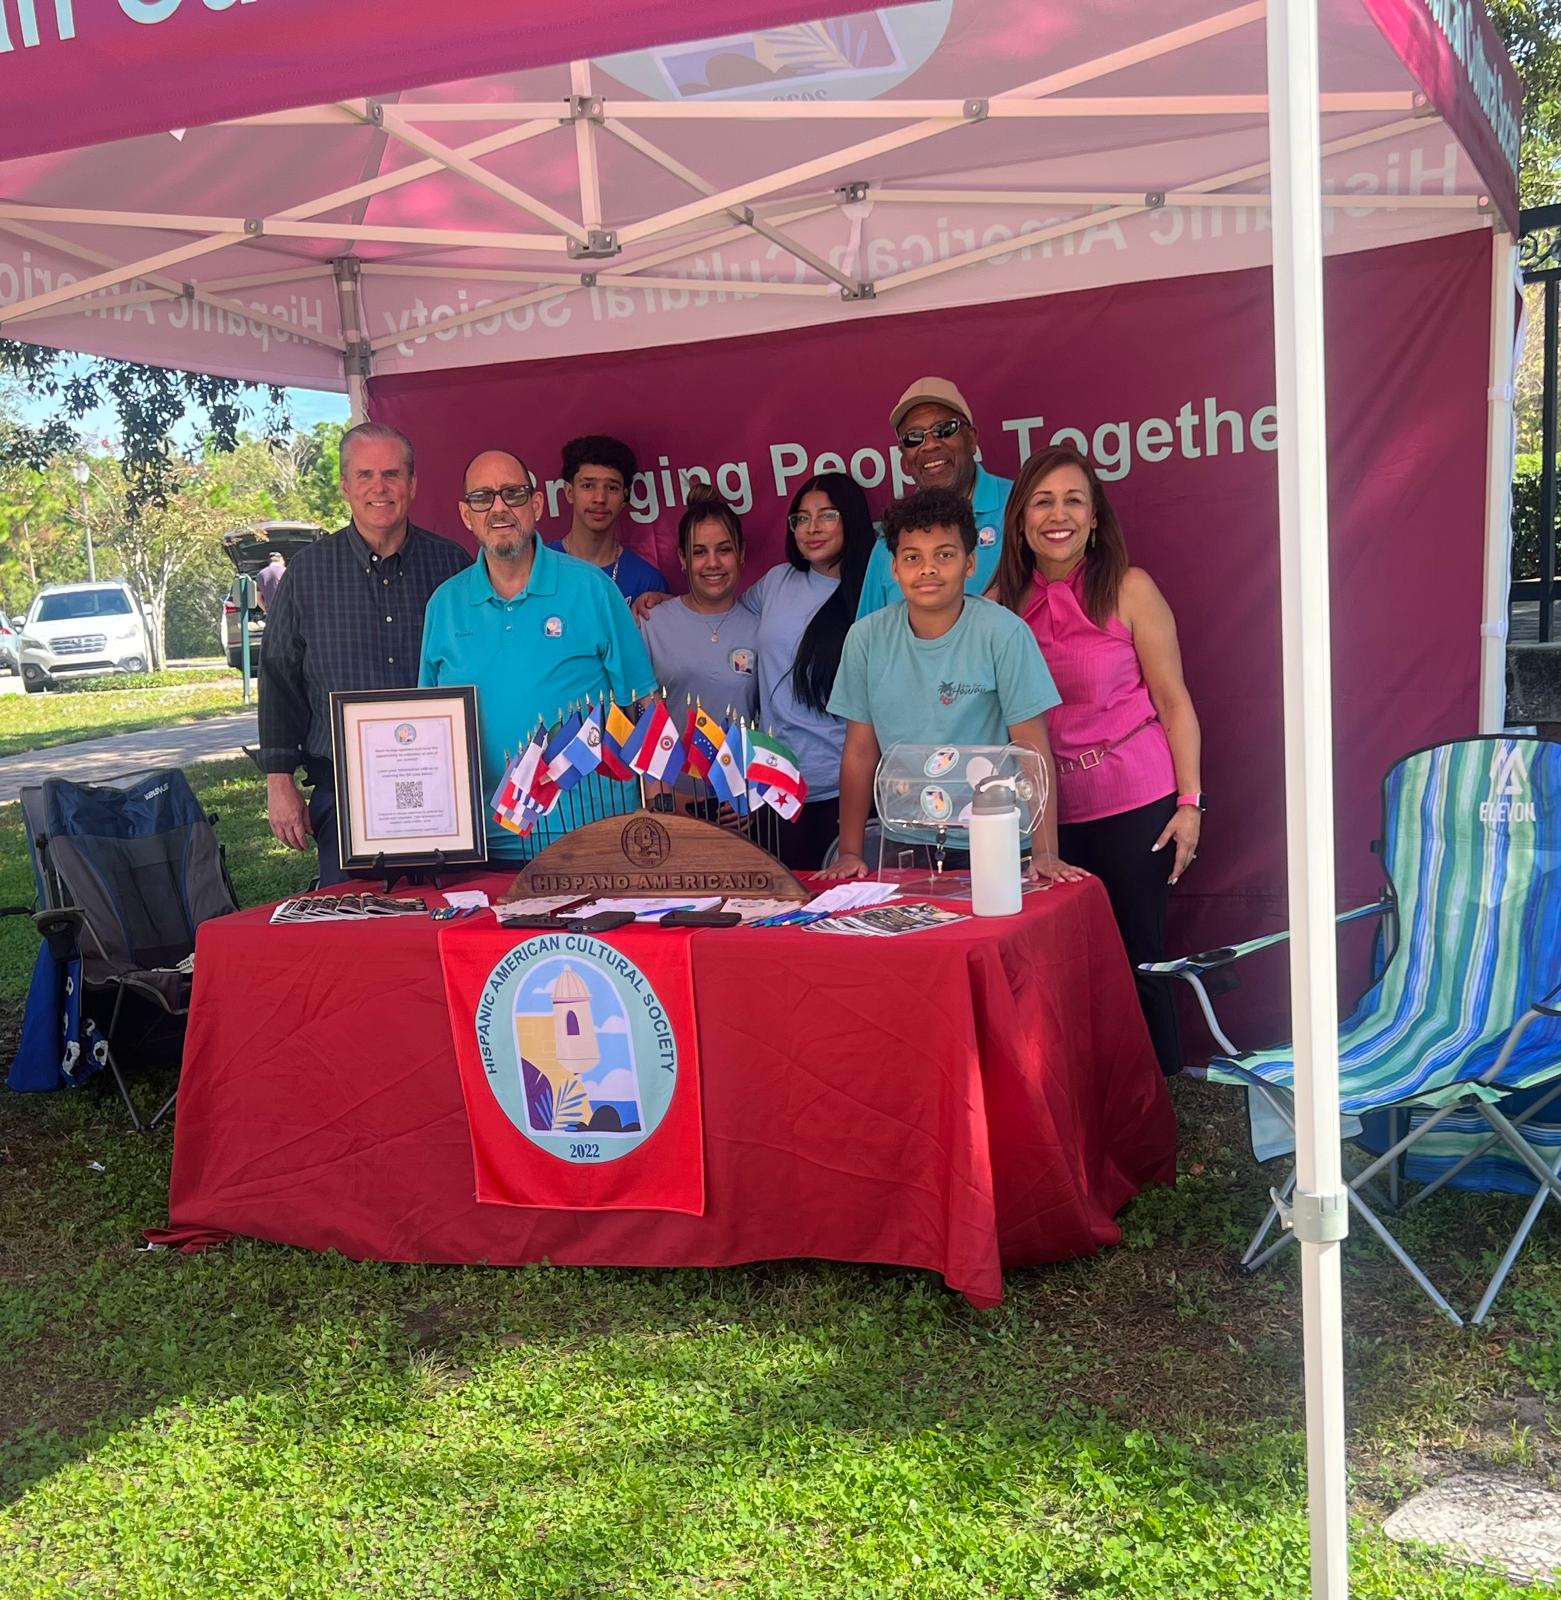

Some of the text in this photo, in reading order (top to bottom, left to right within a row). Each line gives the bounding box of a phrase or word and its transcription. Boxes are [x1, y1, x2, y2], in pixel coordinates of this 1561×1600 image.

[769, 442, 982, 500] Peop
[1002, 396, 1279, 483] Togethe
[1479, 801, 1537, 822] ELEVON
[535, 873, 770, 890] HISPANO AMERICANO
[477, 935, 675, 1075] HISPANIC AMERICAN CULTURAL SOCIETY
[569, 1143, 600, 1159] 2022
